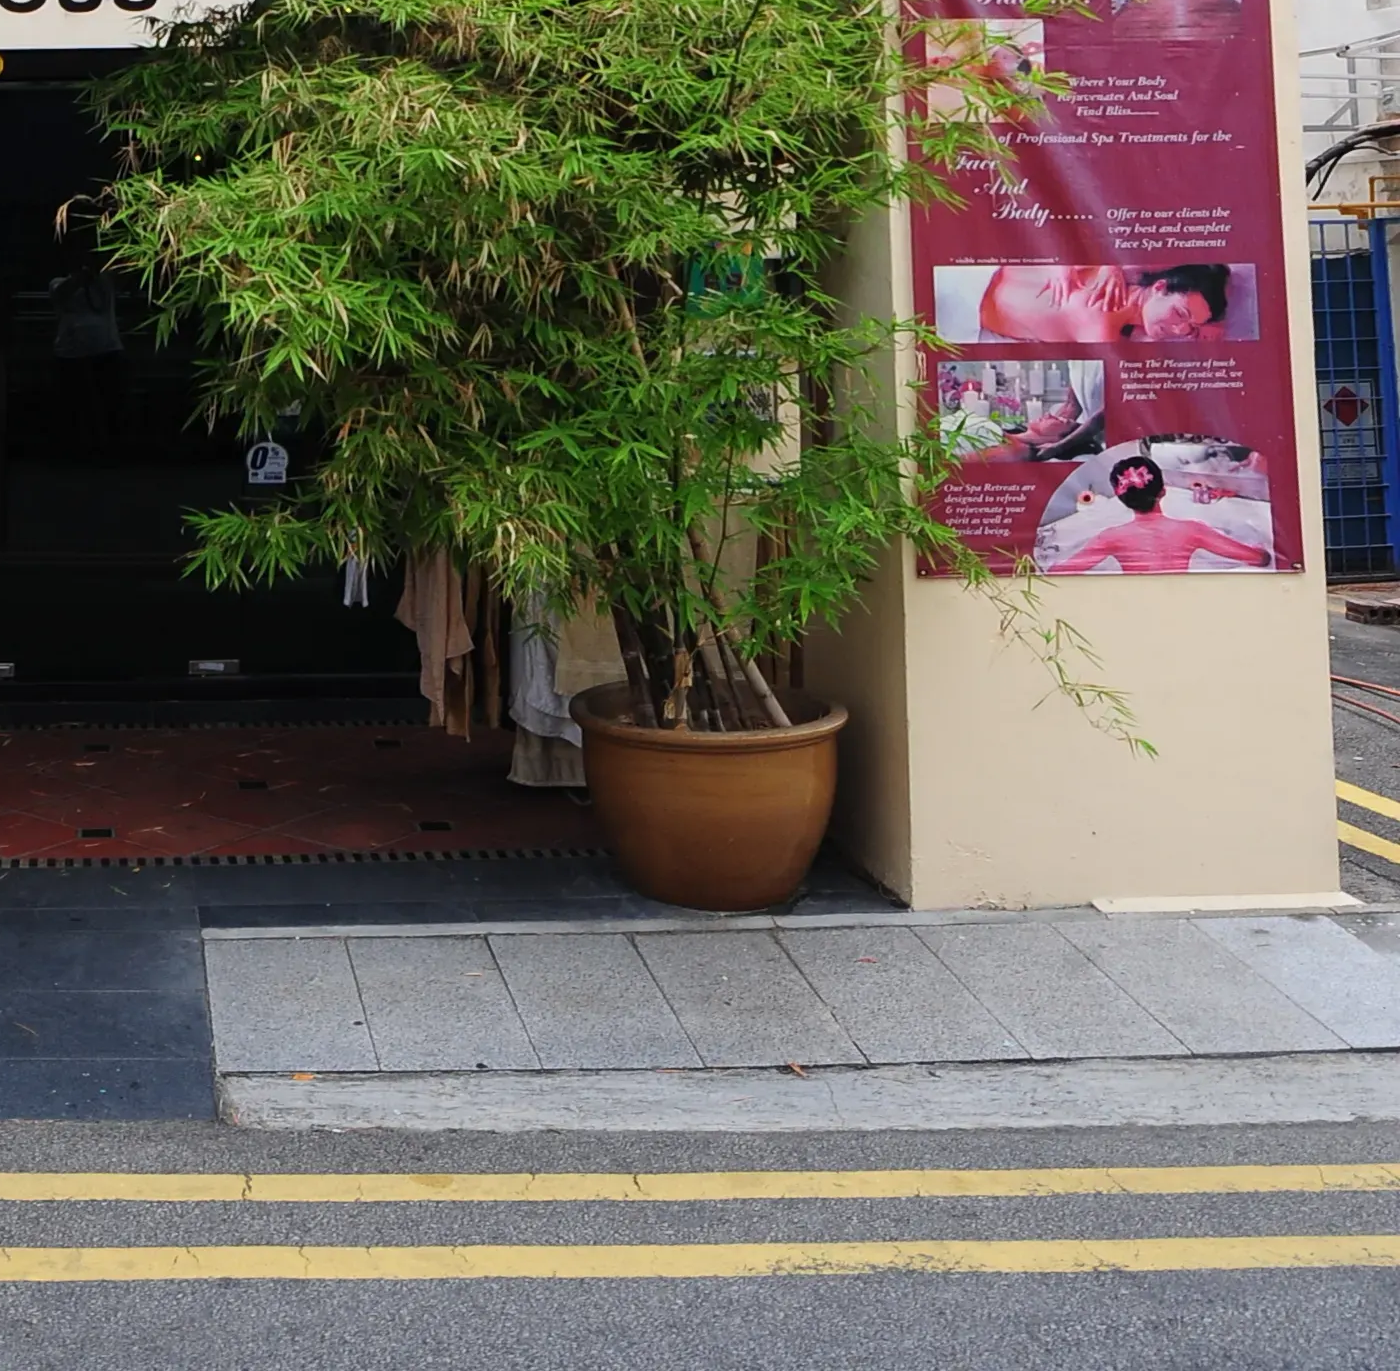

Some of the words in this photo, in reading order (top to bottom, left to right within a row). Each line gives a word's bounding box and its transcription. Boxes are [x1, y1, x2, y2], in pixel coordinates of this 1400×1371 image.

[1068, 76, 1104, 88] Where
[1107, 76, 1135, 87] Your
[1138, 75, 1167, 88] Body
[1127, 91, 1152, 102] And
[1154, 90, 1179, 101] Soul
[1076, 106, 1102, 116] Find
[998, 132, 1013, 147] of
[1016, 131, 1087, 147] Professional
[1091, 132, 1114, 146] Spa
[1118, 132, 1188, 143] Treatments
[1191, 131, 1209, 145] for
[1211, 130, 1232, 142] the
[1107, 208, 1138, 221] Offer
[1140, 209, 1152, 219] to
[1154, 210, 1174, 219] our
[1176, 207, 1210, 219] clients
[1212, 206, 1231, 218] the
[1108, 225, 1132, 237] very
[1134, 223, 1157, 234] best
[1159, 222, 1181, 234] and
[1183, 222, 1232, 235] complete
[1114, 239, 1139, 249] Face
[1141, 238, 1163, 251] Spa
[1165, 238, 1227, 248] Treatments
[944, 484, 963, 492] Our
[984, 483, 1020, 492] Retreats
